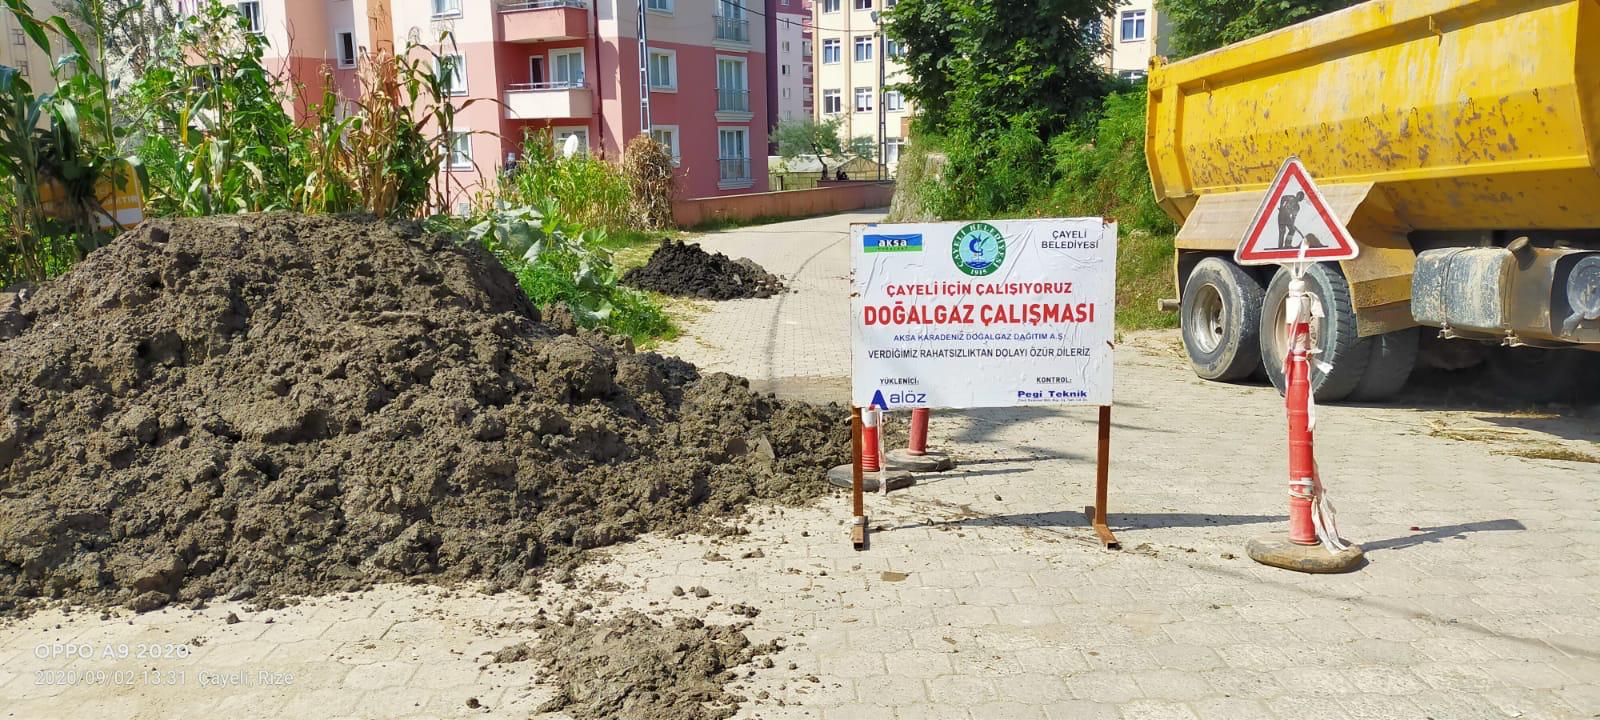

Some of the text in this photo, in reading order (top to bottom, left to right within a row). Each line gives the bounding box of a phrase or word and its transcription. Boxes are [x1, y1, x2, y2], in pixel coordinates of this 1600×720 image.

[1052, 229, 1087, 240] ÇAYELİ
[878, 239, 907, 247] aksa
[1041, 240, 1099, 249] BELEDİYESİ
[886, 281, 1073, 297] ÇAYELİ İÇİN ÇALIŞIYORUZ
[864, 301, 1095, 326] DOĞALGAZ ÇALIŞMASI
[1013, 332, 1048, 341] DAĞITIM
[868, 346, 1090, 359] VERDİĞİMİZ RAHATSIZLIKTAN DOLAYI ÖZÜR DİLERİZ
[880, 377, 920, 385] YÜKLENİCİ:
[1036, 376, 1072, 384] KONTROL:
[889, 390, 927, 404] alöz
[1017, 390, 1088, 398] Pegi Teknik
